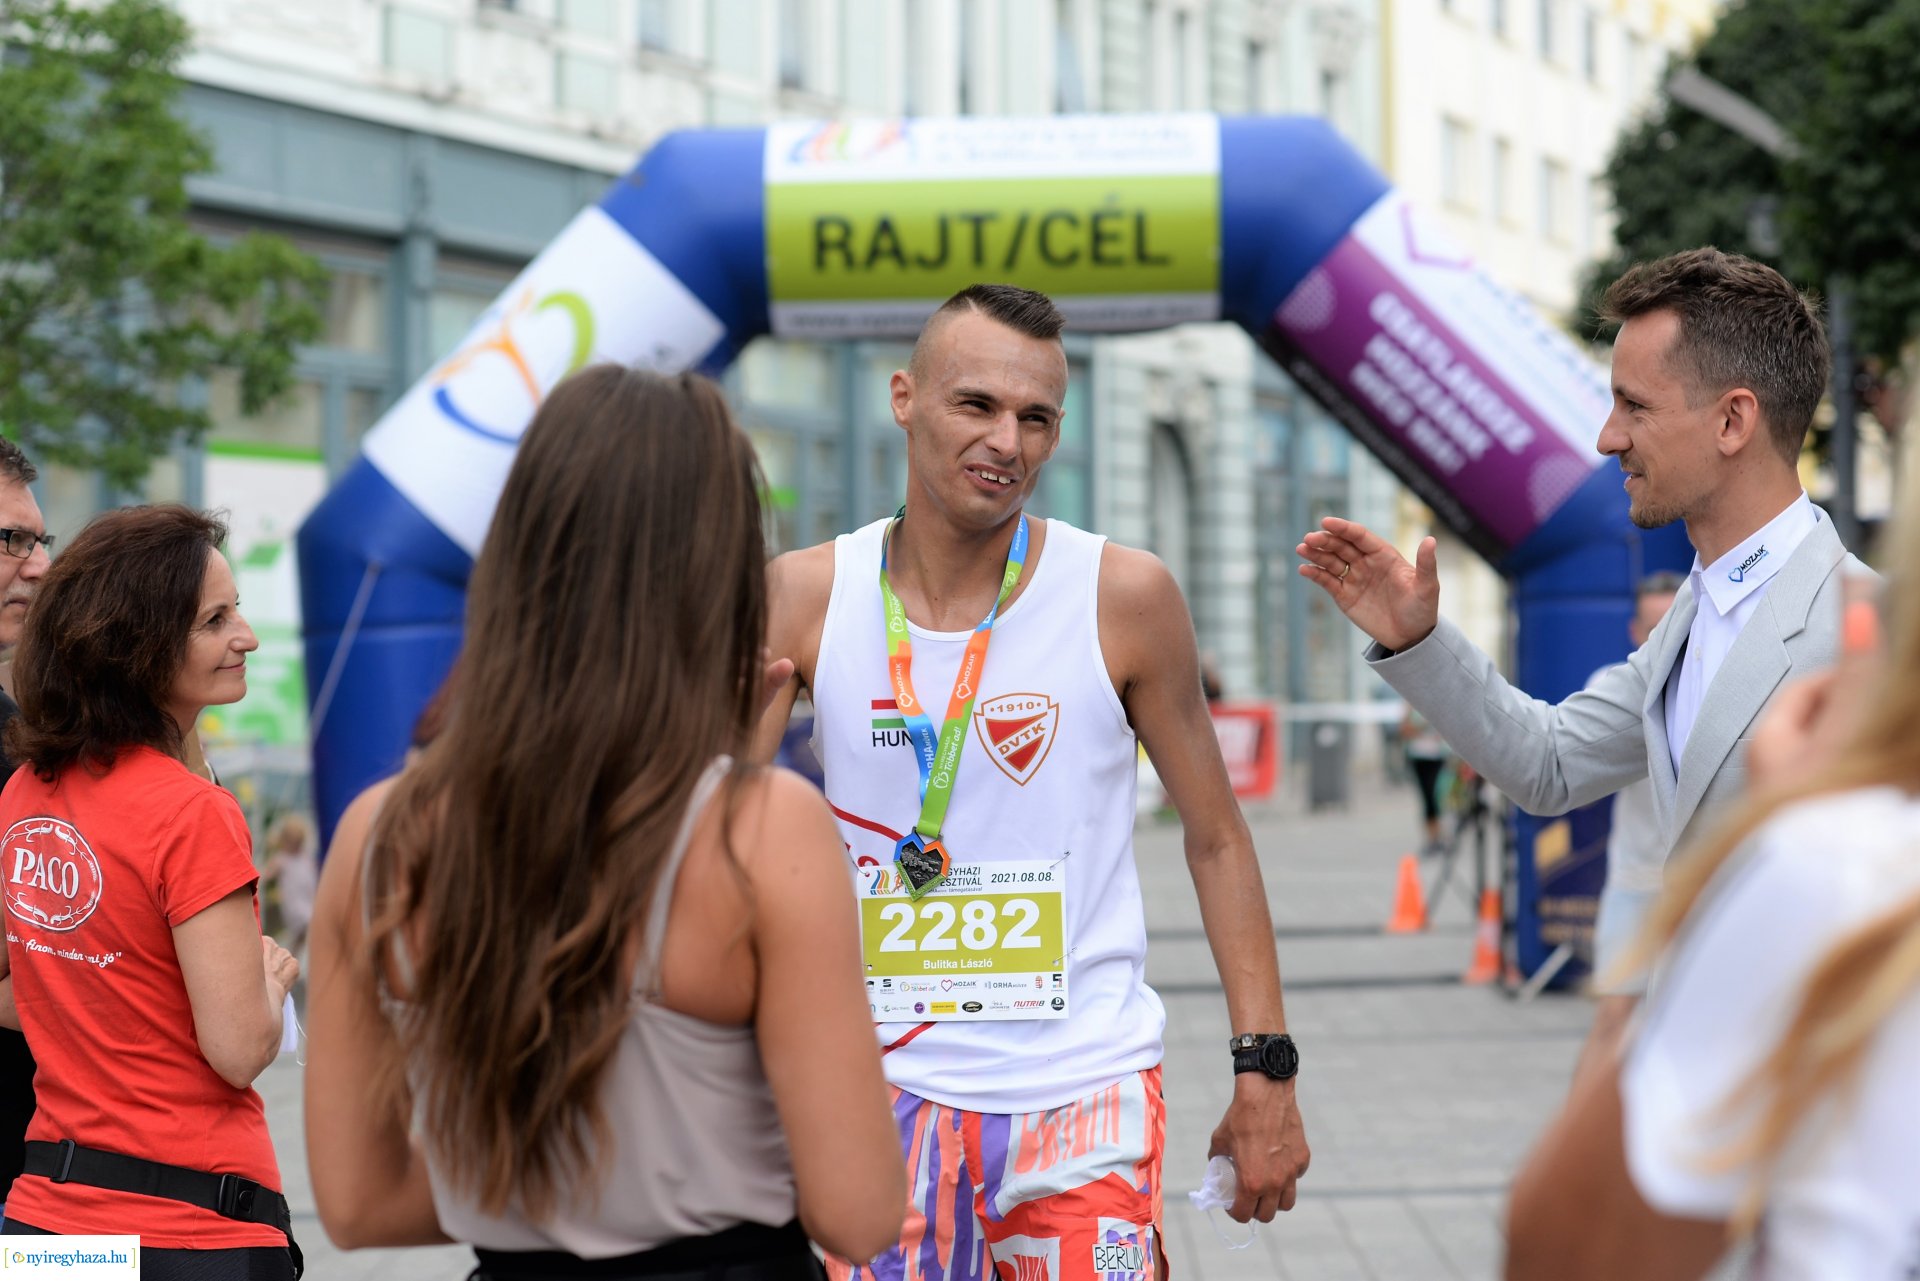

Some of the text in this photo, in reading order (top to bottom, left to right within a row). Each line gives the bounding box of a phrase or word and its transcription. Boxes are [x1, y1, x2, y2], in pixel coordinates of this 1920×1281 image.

[813, 194, 1171, 271] RAJT/CÉL
[1740, 545, 1766, 571] MOZAIK
[895, 663, 905, 693] MOZAIK
[963, 653, 976, 684] MOZAIK
[997, 701, 1035, 712] 1910
[872, 730, 914, 747] HUN
[998, 722, 1047, 755] DVTK
[944, 742, 958, 771] Többet
[10, 847, 79, 899] PACO
[940, 876, 982, 886] ESZTIVÁL
[948, 866, 981, 876] GYHÁZI
[991, 872, 1055, 883] 2021.08.08.
[879, 899, 1042, 952] 2282
[923, 958, 993, 970] Bulitka László
[1095, 1246, 1143, 1270] BERLIN
